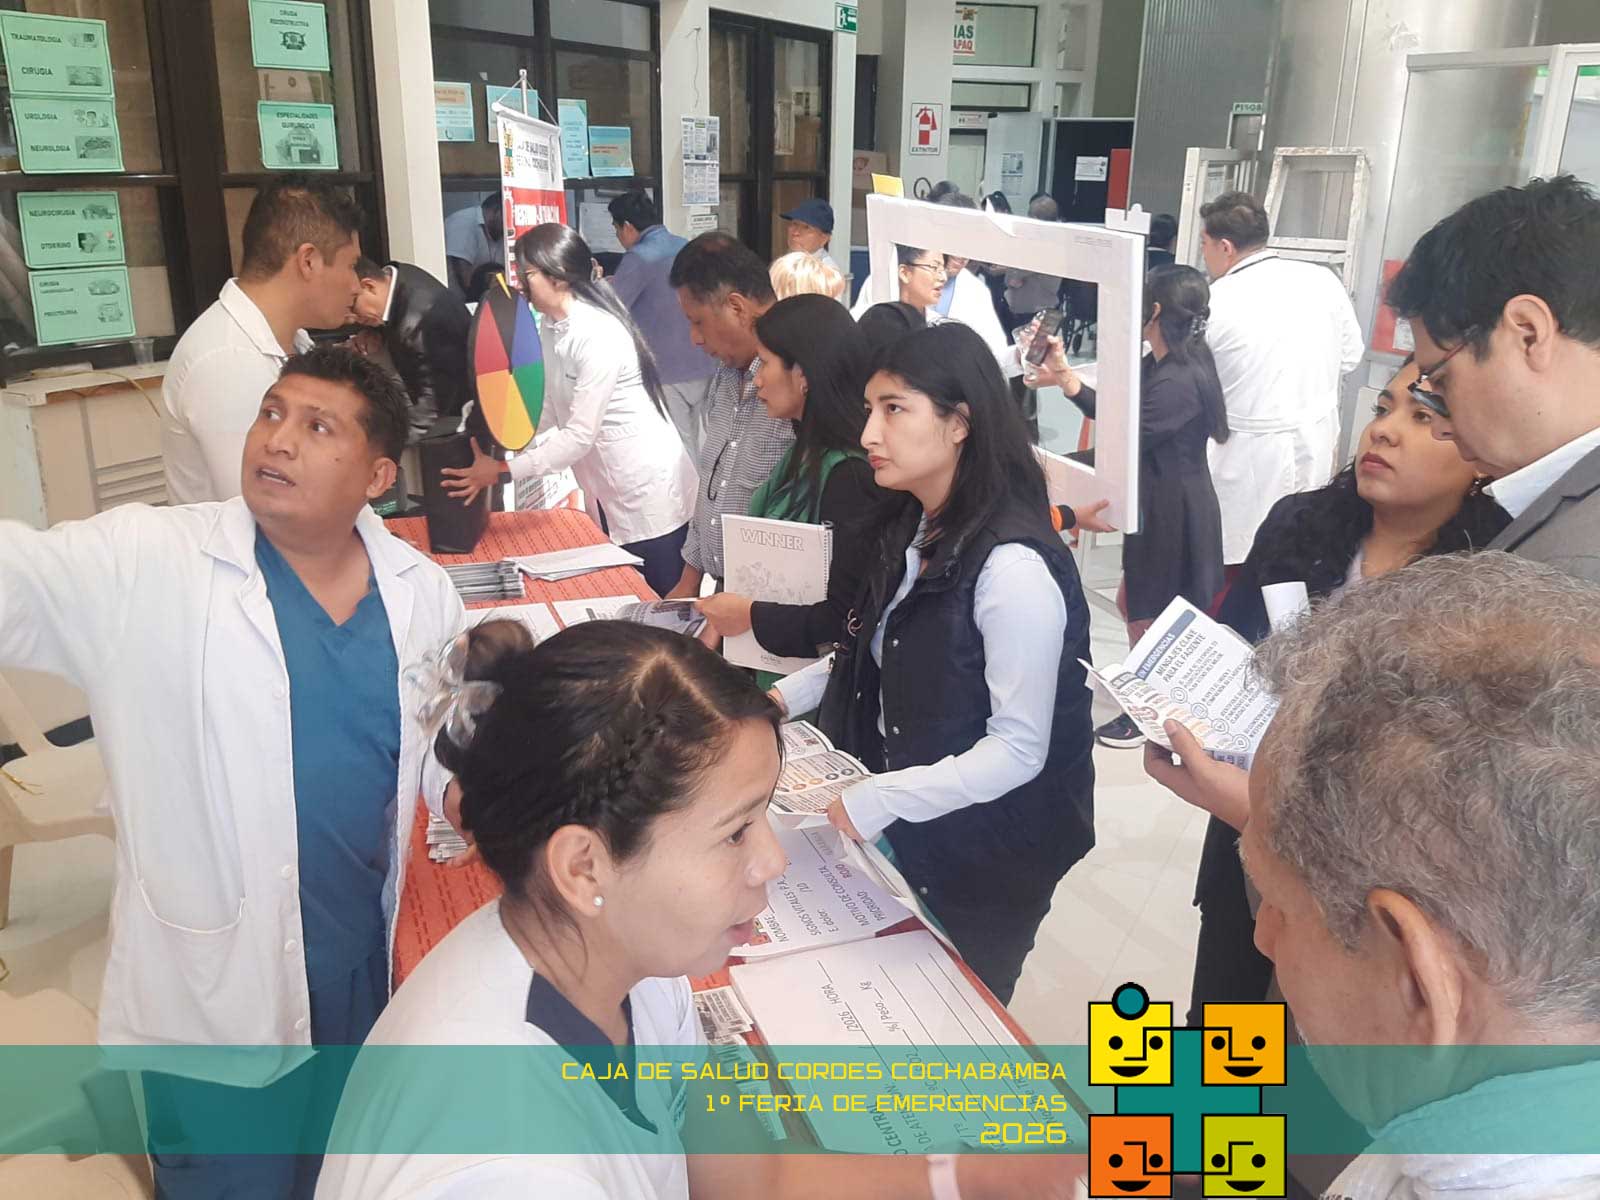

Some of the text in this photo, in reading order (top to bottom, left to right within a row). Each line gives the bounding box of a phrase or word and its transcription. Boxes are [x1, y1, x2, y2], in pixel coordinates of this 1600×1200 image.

[22, 66, 53, 76] CIRUGIA
[740, 528, 804, 550] WINNER
[1155, 628, 1197, 676] MENSAJES CLAVE
[839, 893, 852, 903] DE
[798, 912, 822, 939] SIGNOS
[845, 902, 870, 928] MOTIVO
[821, 983, 842, 1006] HORA
[838, 1009, 863, 1035] /2026
